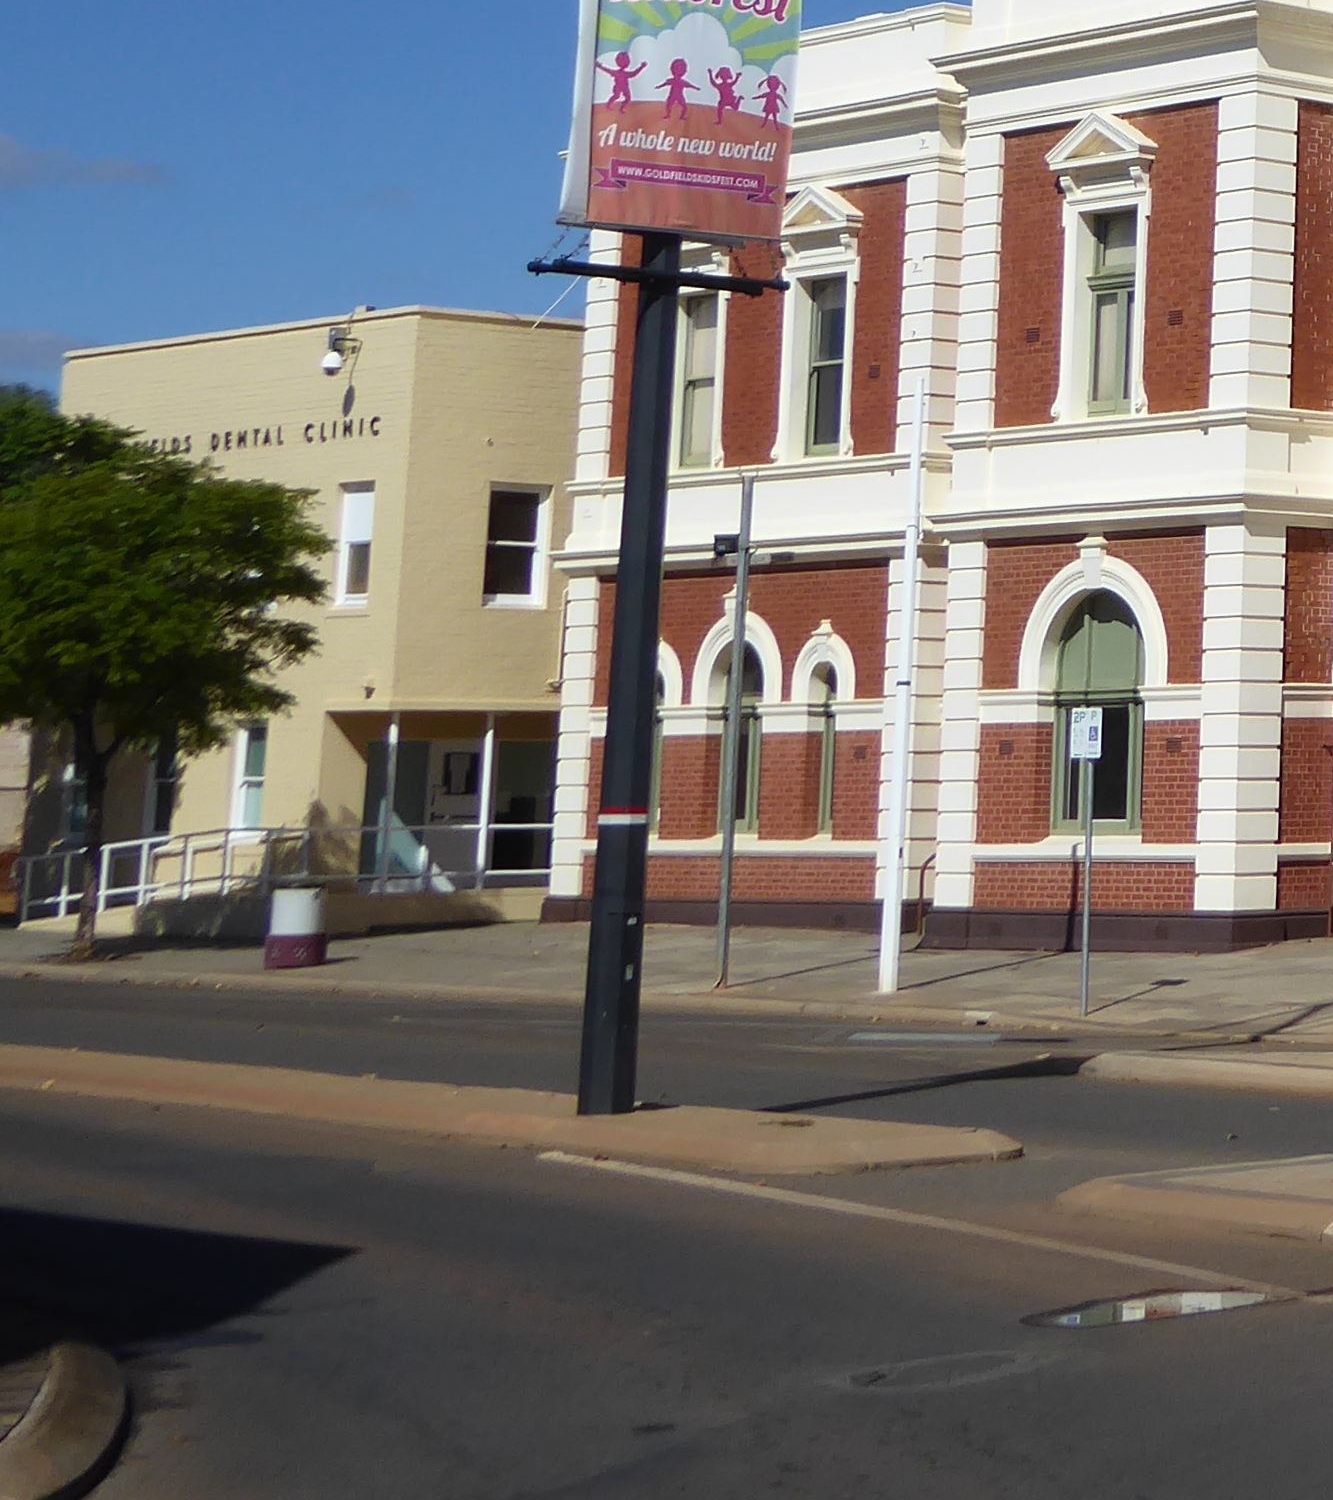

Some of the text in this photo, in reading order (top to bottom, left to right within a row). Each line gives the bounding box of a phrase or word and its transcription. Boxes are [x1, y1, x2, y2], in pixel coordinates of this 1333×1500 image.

[598, 124, 777, 161] A whole new world!
[211, 425, 284, 452] DENTAL
[304, 416, 382, 444] CLINIC
[1074, 711, 1086, 723] 2P
